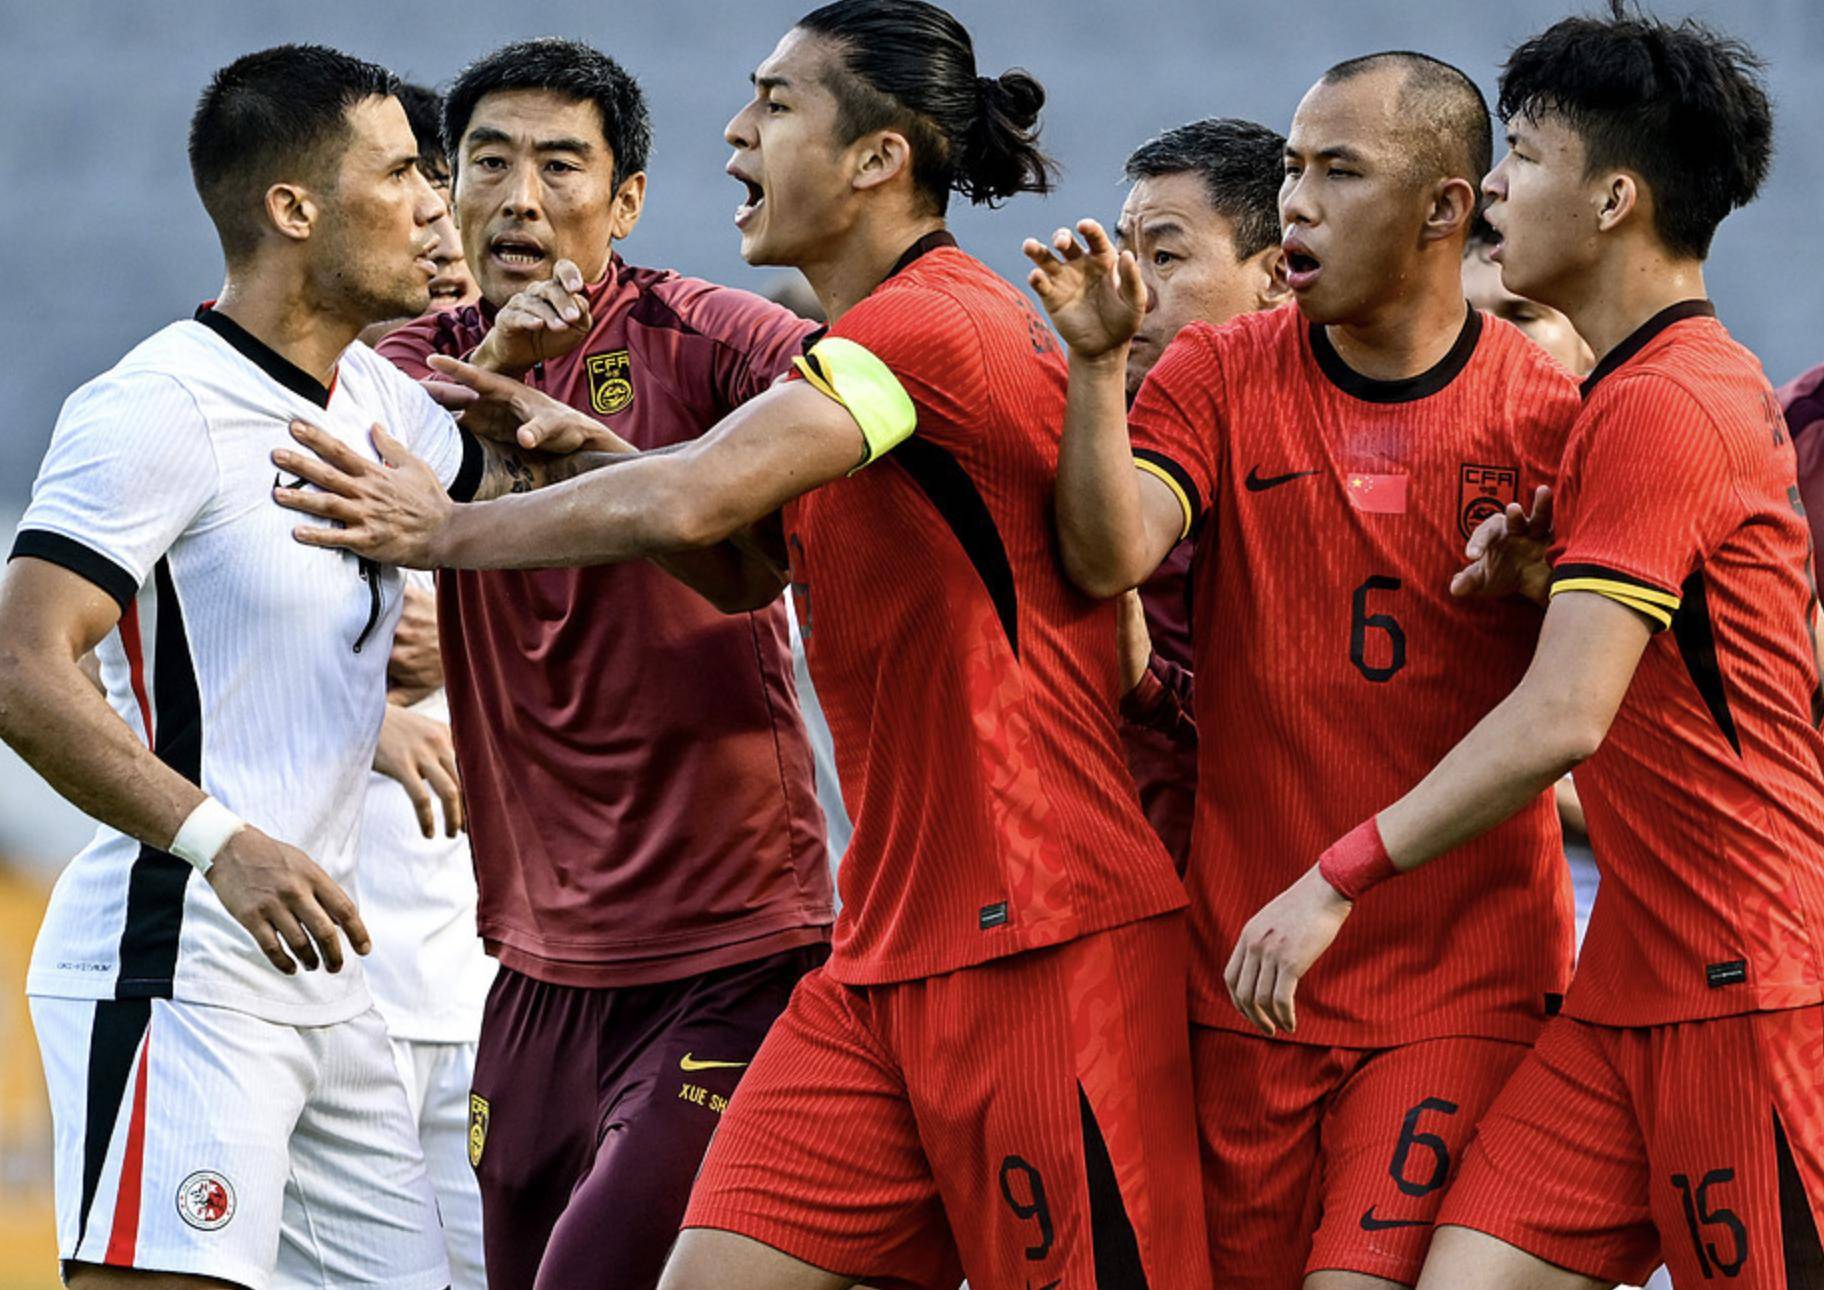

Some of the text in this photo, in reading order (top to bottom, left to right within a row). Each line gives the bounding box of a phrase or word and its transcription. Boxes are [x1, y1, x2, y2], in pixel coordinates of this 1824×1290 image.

[592, 355, 630, 374] CFA
[1466, 469, 1513, 486] CFA
[1350, 574, 1406, 682] 6
[678, 1083, 708, 1106] XUE
[1389, 1096, 1459, 1197] 6
[999, 1155, 1055, 1261] 9
[1671, 1168, 1748, 1279] 15
